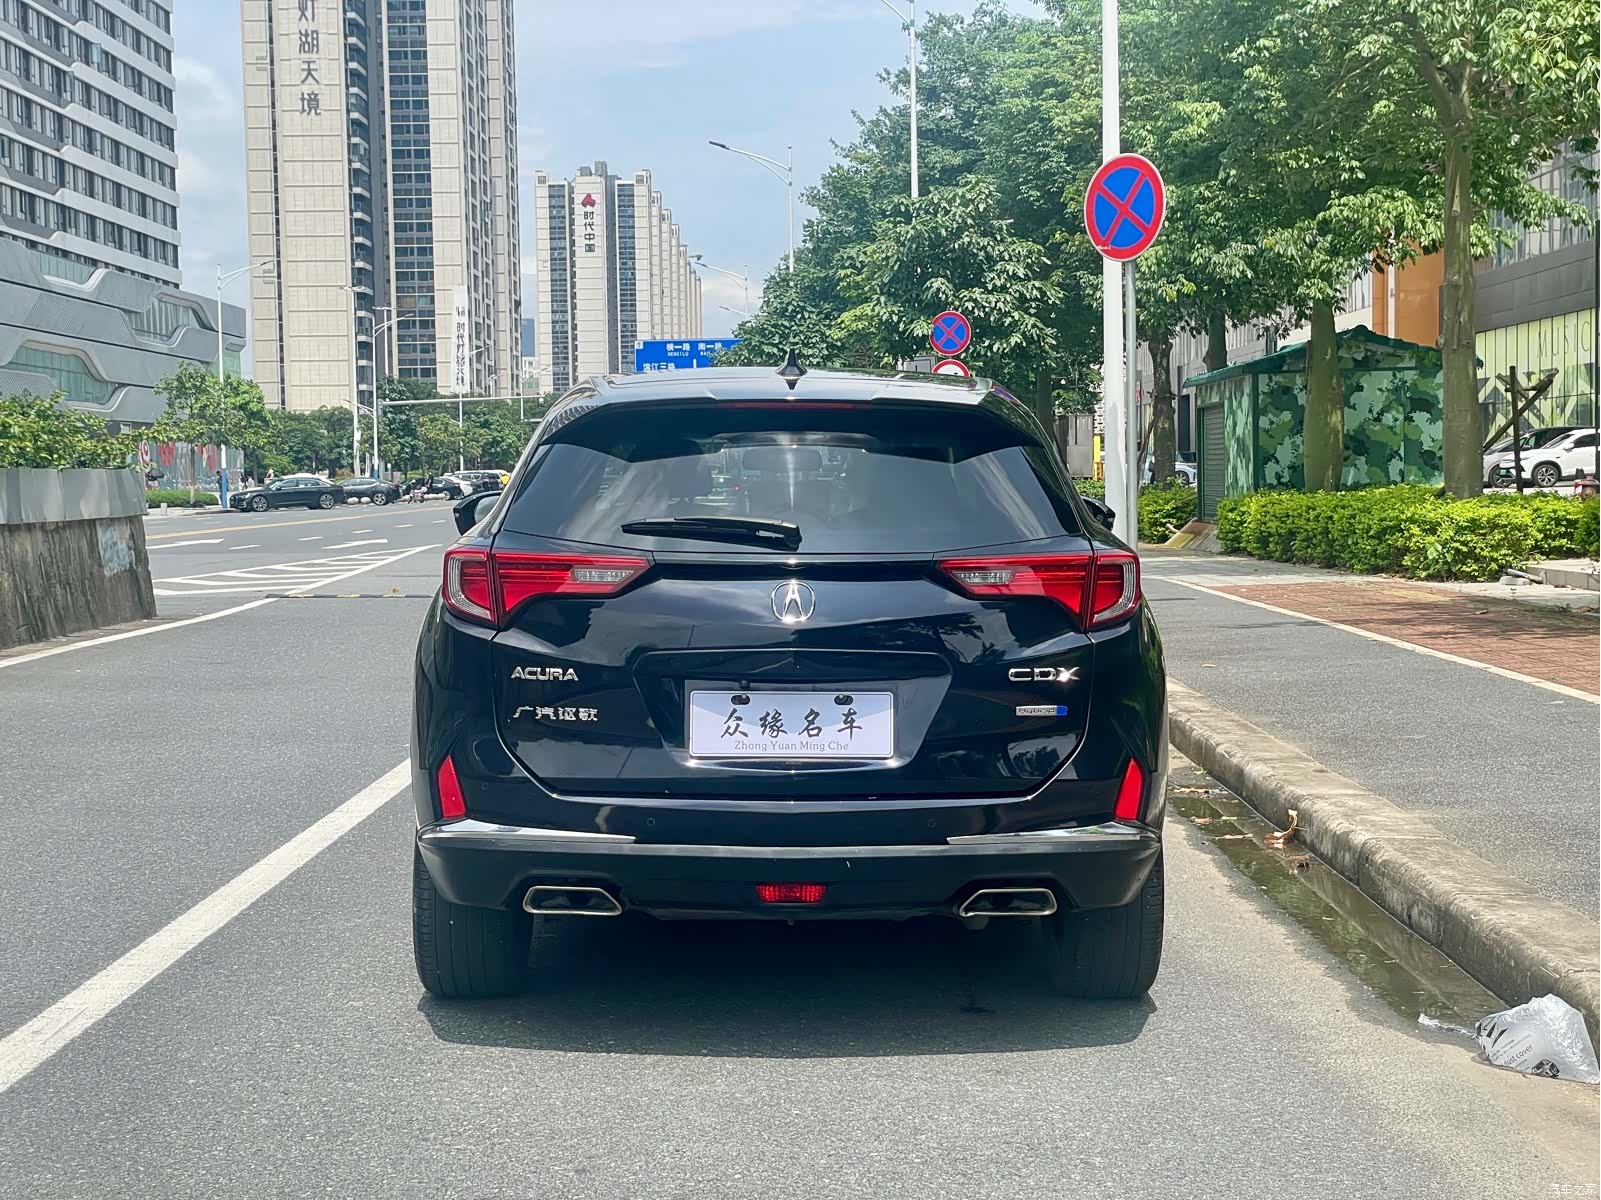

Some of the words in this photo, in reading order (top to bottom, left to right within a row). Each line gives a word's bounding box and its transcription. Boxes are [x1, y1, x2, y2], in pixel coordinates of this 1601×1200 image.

[298, 0, 321, 116] 灯湖天境
[583, 211, 596, 253] 时代中国
[1537, 321, 1589, 358] MUSIC
[510, 666, 579, 681] ACURA
[1008, 666, 1080, 682] CDX
[512, 706, 598, 721] 广汽讴歌
[721, 707, 863, 740] 众缘名车
[734, 740, 767, 751] Zhong
[770, 740, 797, 750] Yuan
[800, 740, 825, 751] Ming
[828, 740, 849, 750] Che
[1516, 1044, 1533, 1059] cover
